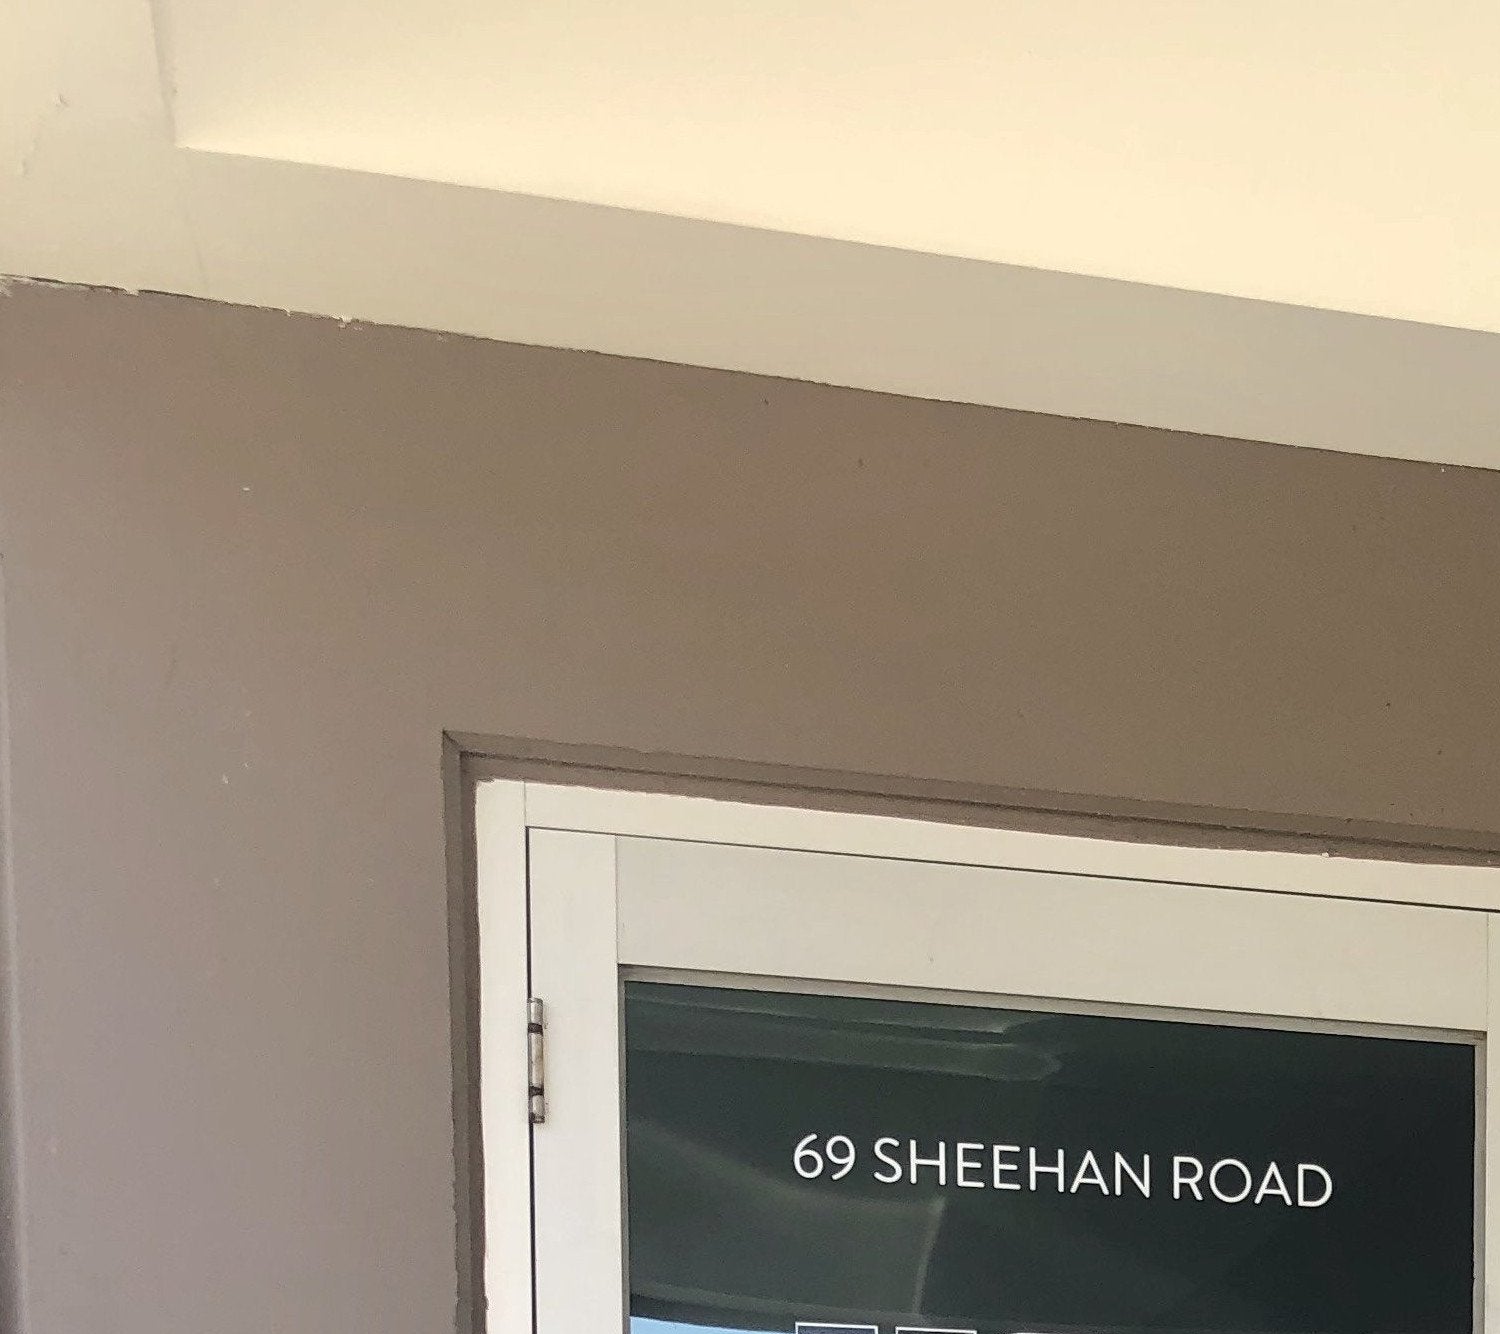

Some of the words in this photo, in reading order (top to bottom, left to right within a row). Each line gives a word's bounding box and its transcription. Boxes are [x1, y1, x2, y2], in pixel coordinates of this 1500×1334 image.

[793, 1134, 855, 1181] 69
[873, 1138, 1151, 1199] SHEEHAN
[1172, 1156, 1333, 1208] ROAD
